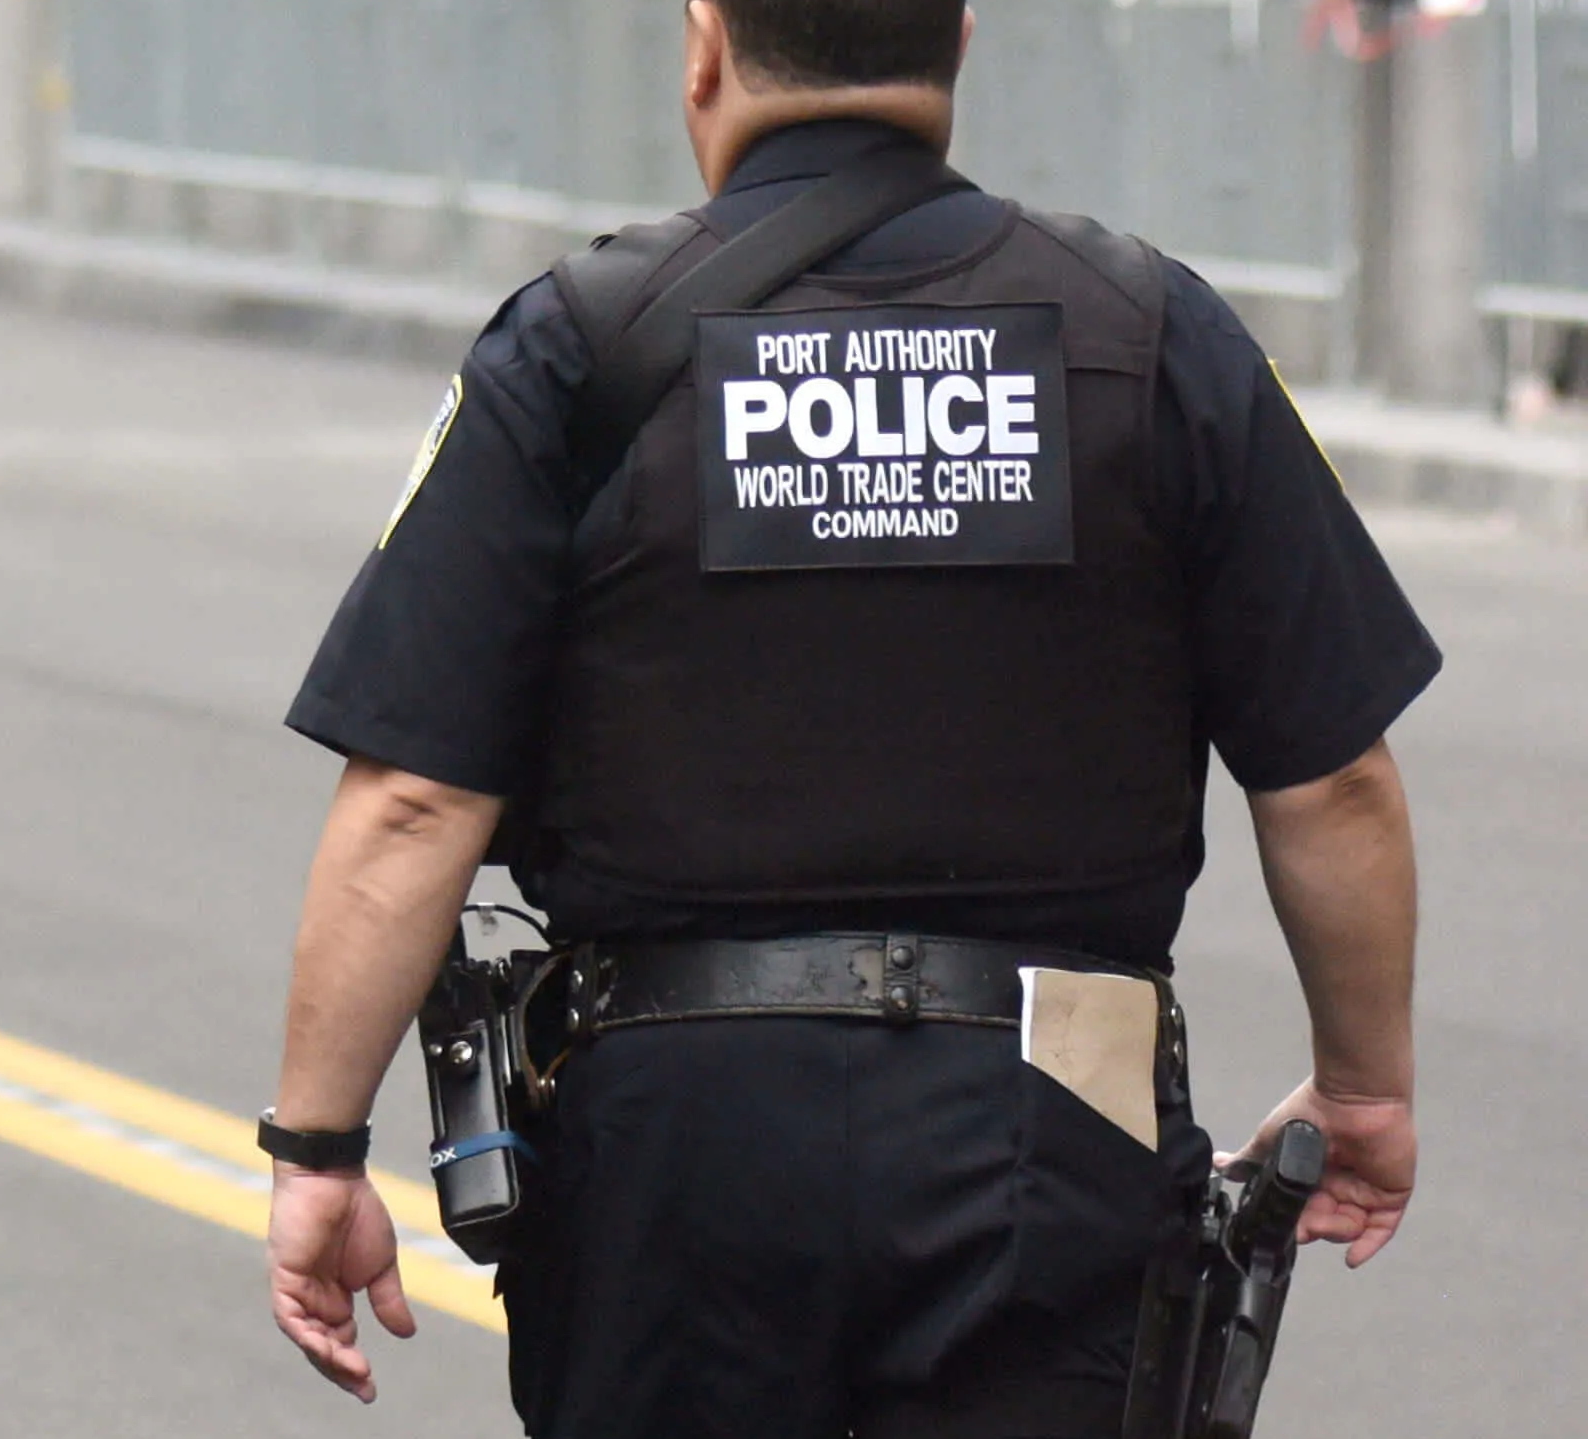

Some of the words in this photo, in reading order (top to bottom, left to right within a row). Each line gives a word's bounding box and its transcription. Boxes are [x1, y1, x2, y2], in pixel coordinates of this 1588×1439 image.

[757, 333, 831, 375] PORT
[844, 329, 996, 373] AUTHORITY
[723, 374, 1039, 461] POLICE
[734, 465, 828, 509] WORLD
[838, 462, 924, 506] TRADE
[933, 460, 1034, 503] CENTER
[812, 509, 959, 540] COMMAND
